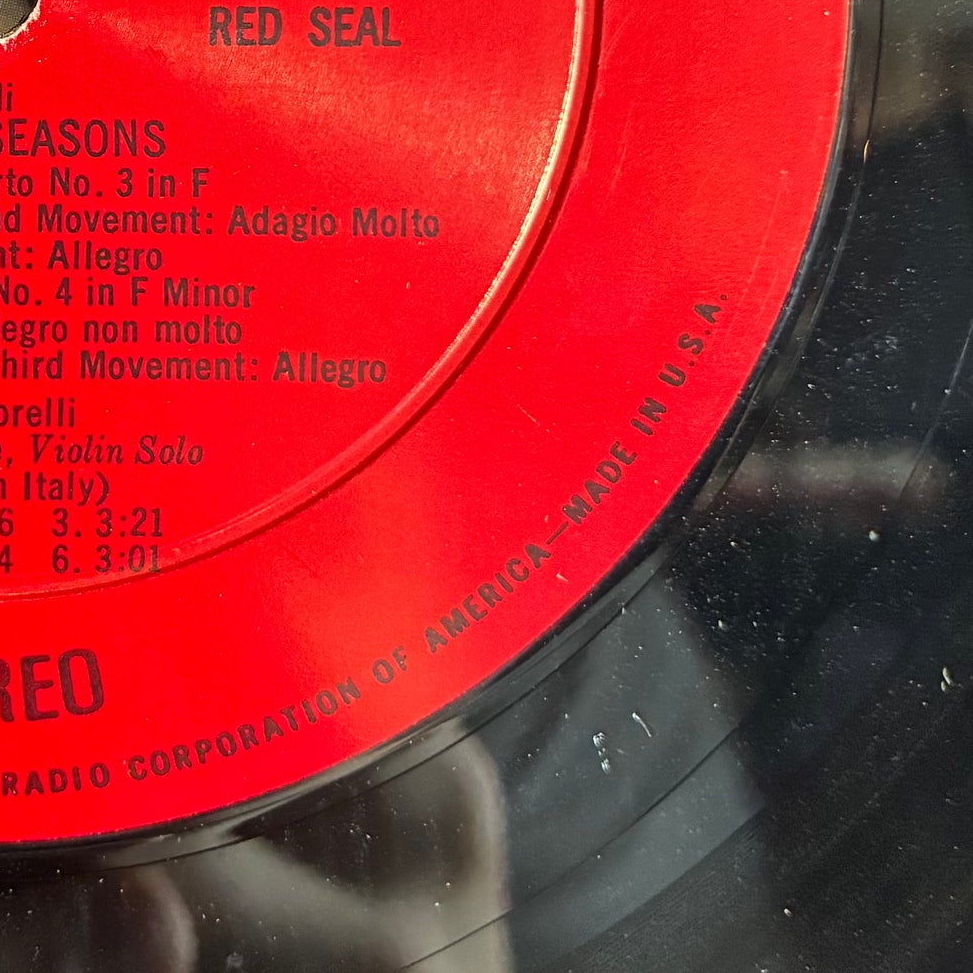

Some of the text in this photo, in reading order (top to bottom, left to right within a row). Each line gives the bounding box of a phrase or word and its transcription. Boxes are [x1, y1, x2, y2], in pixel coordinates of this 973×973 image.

[208, 5, 402, 48] RED SEAL
[49, 166, 104, 198] No.
[115, 167, 133, 198] 3
[147, 167, 176, 199] in
[191, 167, 210, 199] F
[36, 203, 213, 236] Movement:
[227, 205, 337, 243] Adagio
[352, 207, 440, 239] Molto
[46, 239, 163, 276] Allegro
[54, 276, 73, 307] 4
[86, 276, 115, 307] in
[130, 276, 149, 307] F
[162, 276, 256, 309] Minor
[83, 319, 138, 344] non
[154, 314, 243, 345] molto
[79, 349, 258, 382] Movement:
[272, 350, 387, 389] Allegro
[29, 433, 124, 465] Violin
[133, 434, 204, 466] Solo
[23, 470, 110, 507] Italy)
[51, 507, 82, 539] 3.
[95, 506, 163, 539] 3:21
[1, 762, 111, 797] RADIO
[127, 676, 361, 782] CORPORATION
[372, 646, 407, 685] OF
[630, 396, 668, 436] IN
[657, 292, 730, 388] U.S.A.
[51, 543, 81, 575] 6.
[94, 543, 163, 575] 3:01
